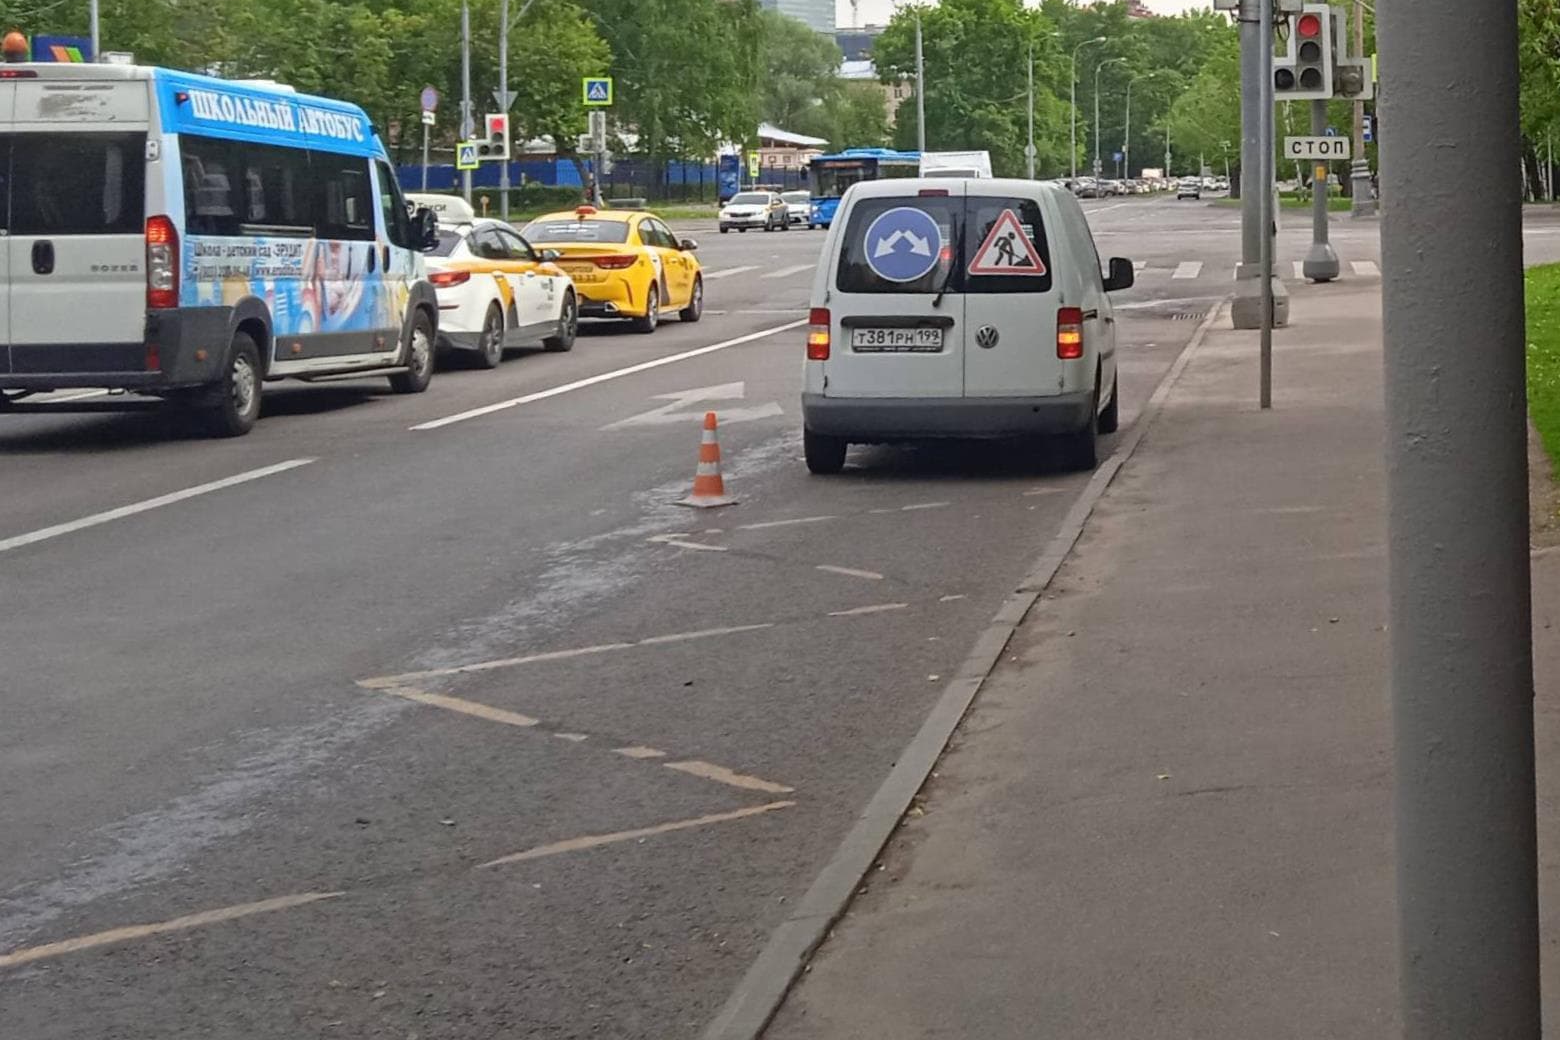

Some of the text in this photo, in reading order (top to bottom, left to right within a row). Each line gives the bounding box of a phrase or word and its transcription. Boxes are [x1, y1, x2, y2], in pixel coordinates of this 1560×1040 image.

[189, 90, 364, 142] ШКОЛЬНЫЙ АВТОБУС
[1292, 141, 1343, 154] СТОП
[858, 330, 940, 344] Т381РН 199
